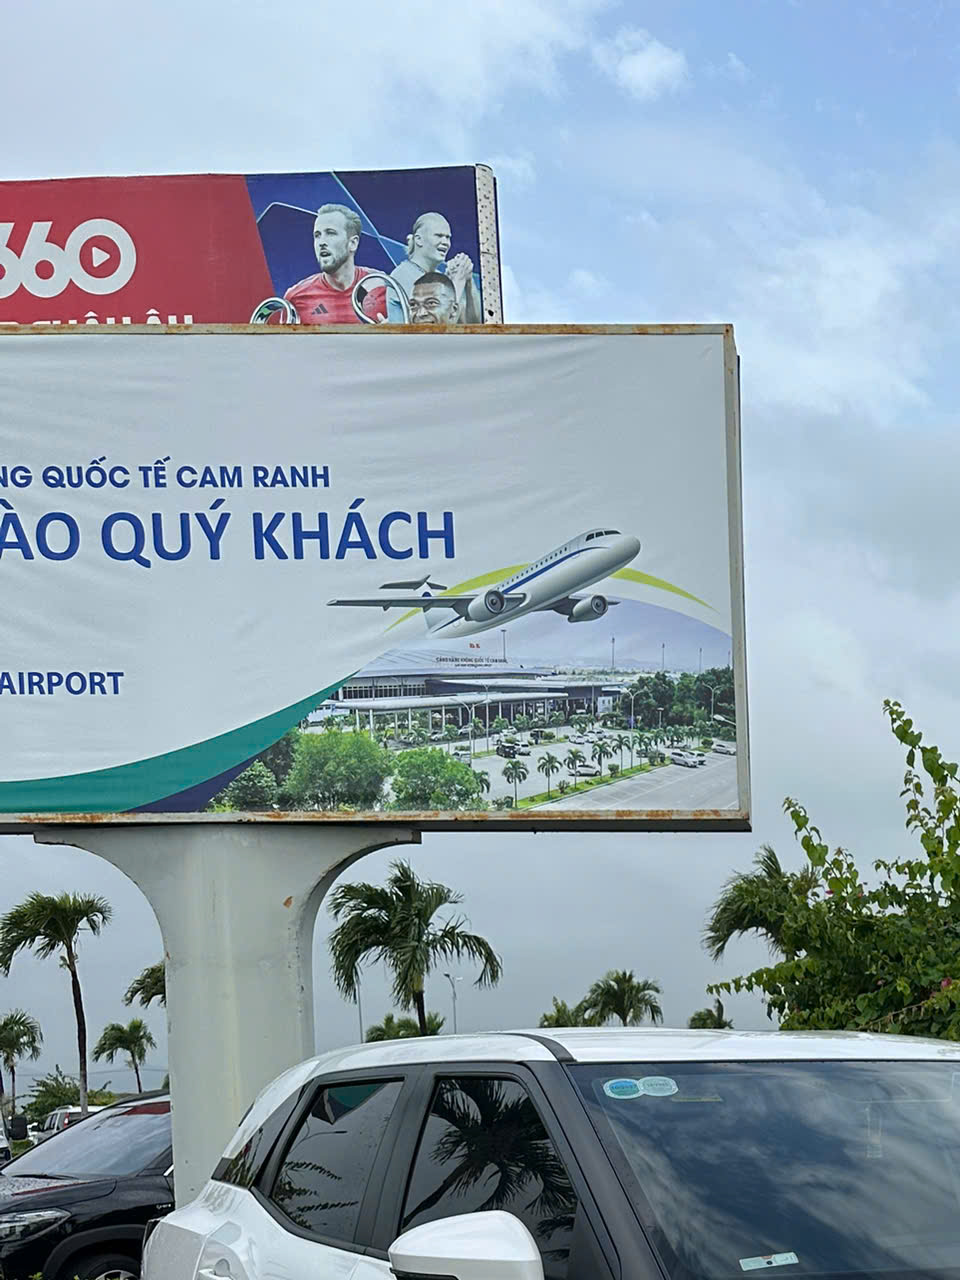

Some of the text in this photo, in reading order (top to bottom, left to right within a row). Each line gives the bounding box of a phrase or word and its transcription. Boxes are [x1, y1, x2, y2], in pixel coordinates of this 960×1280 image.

[42, 456, 129, 489] QUỐC
[139, 456, 172, 489] TẾ
[176, 465, 243, 489] CAM
[253, 465, 330, 488] RANH
[0, 498, 455, 568] ÀO QUÝ KHÁCH
[0, 671, 124, 695] AIRPORT
